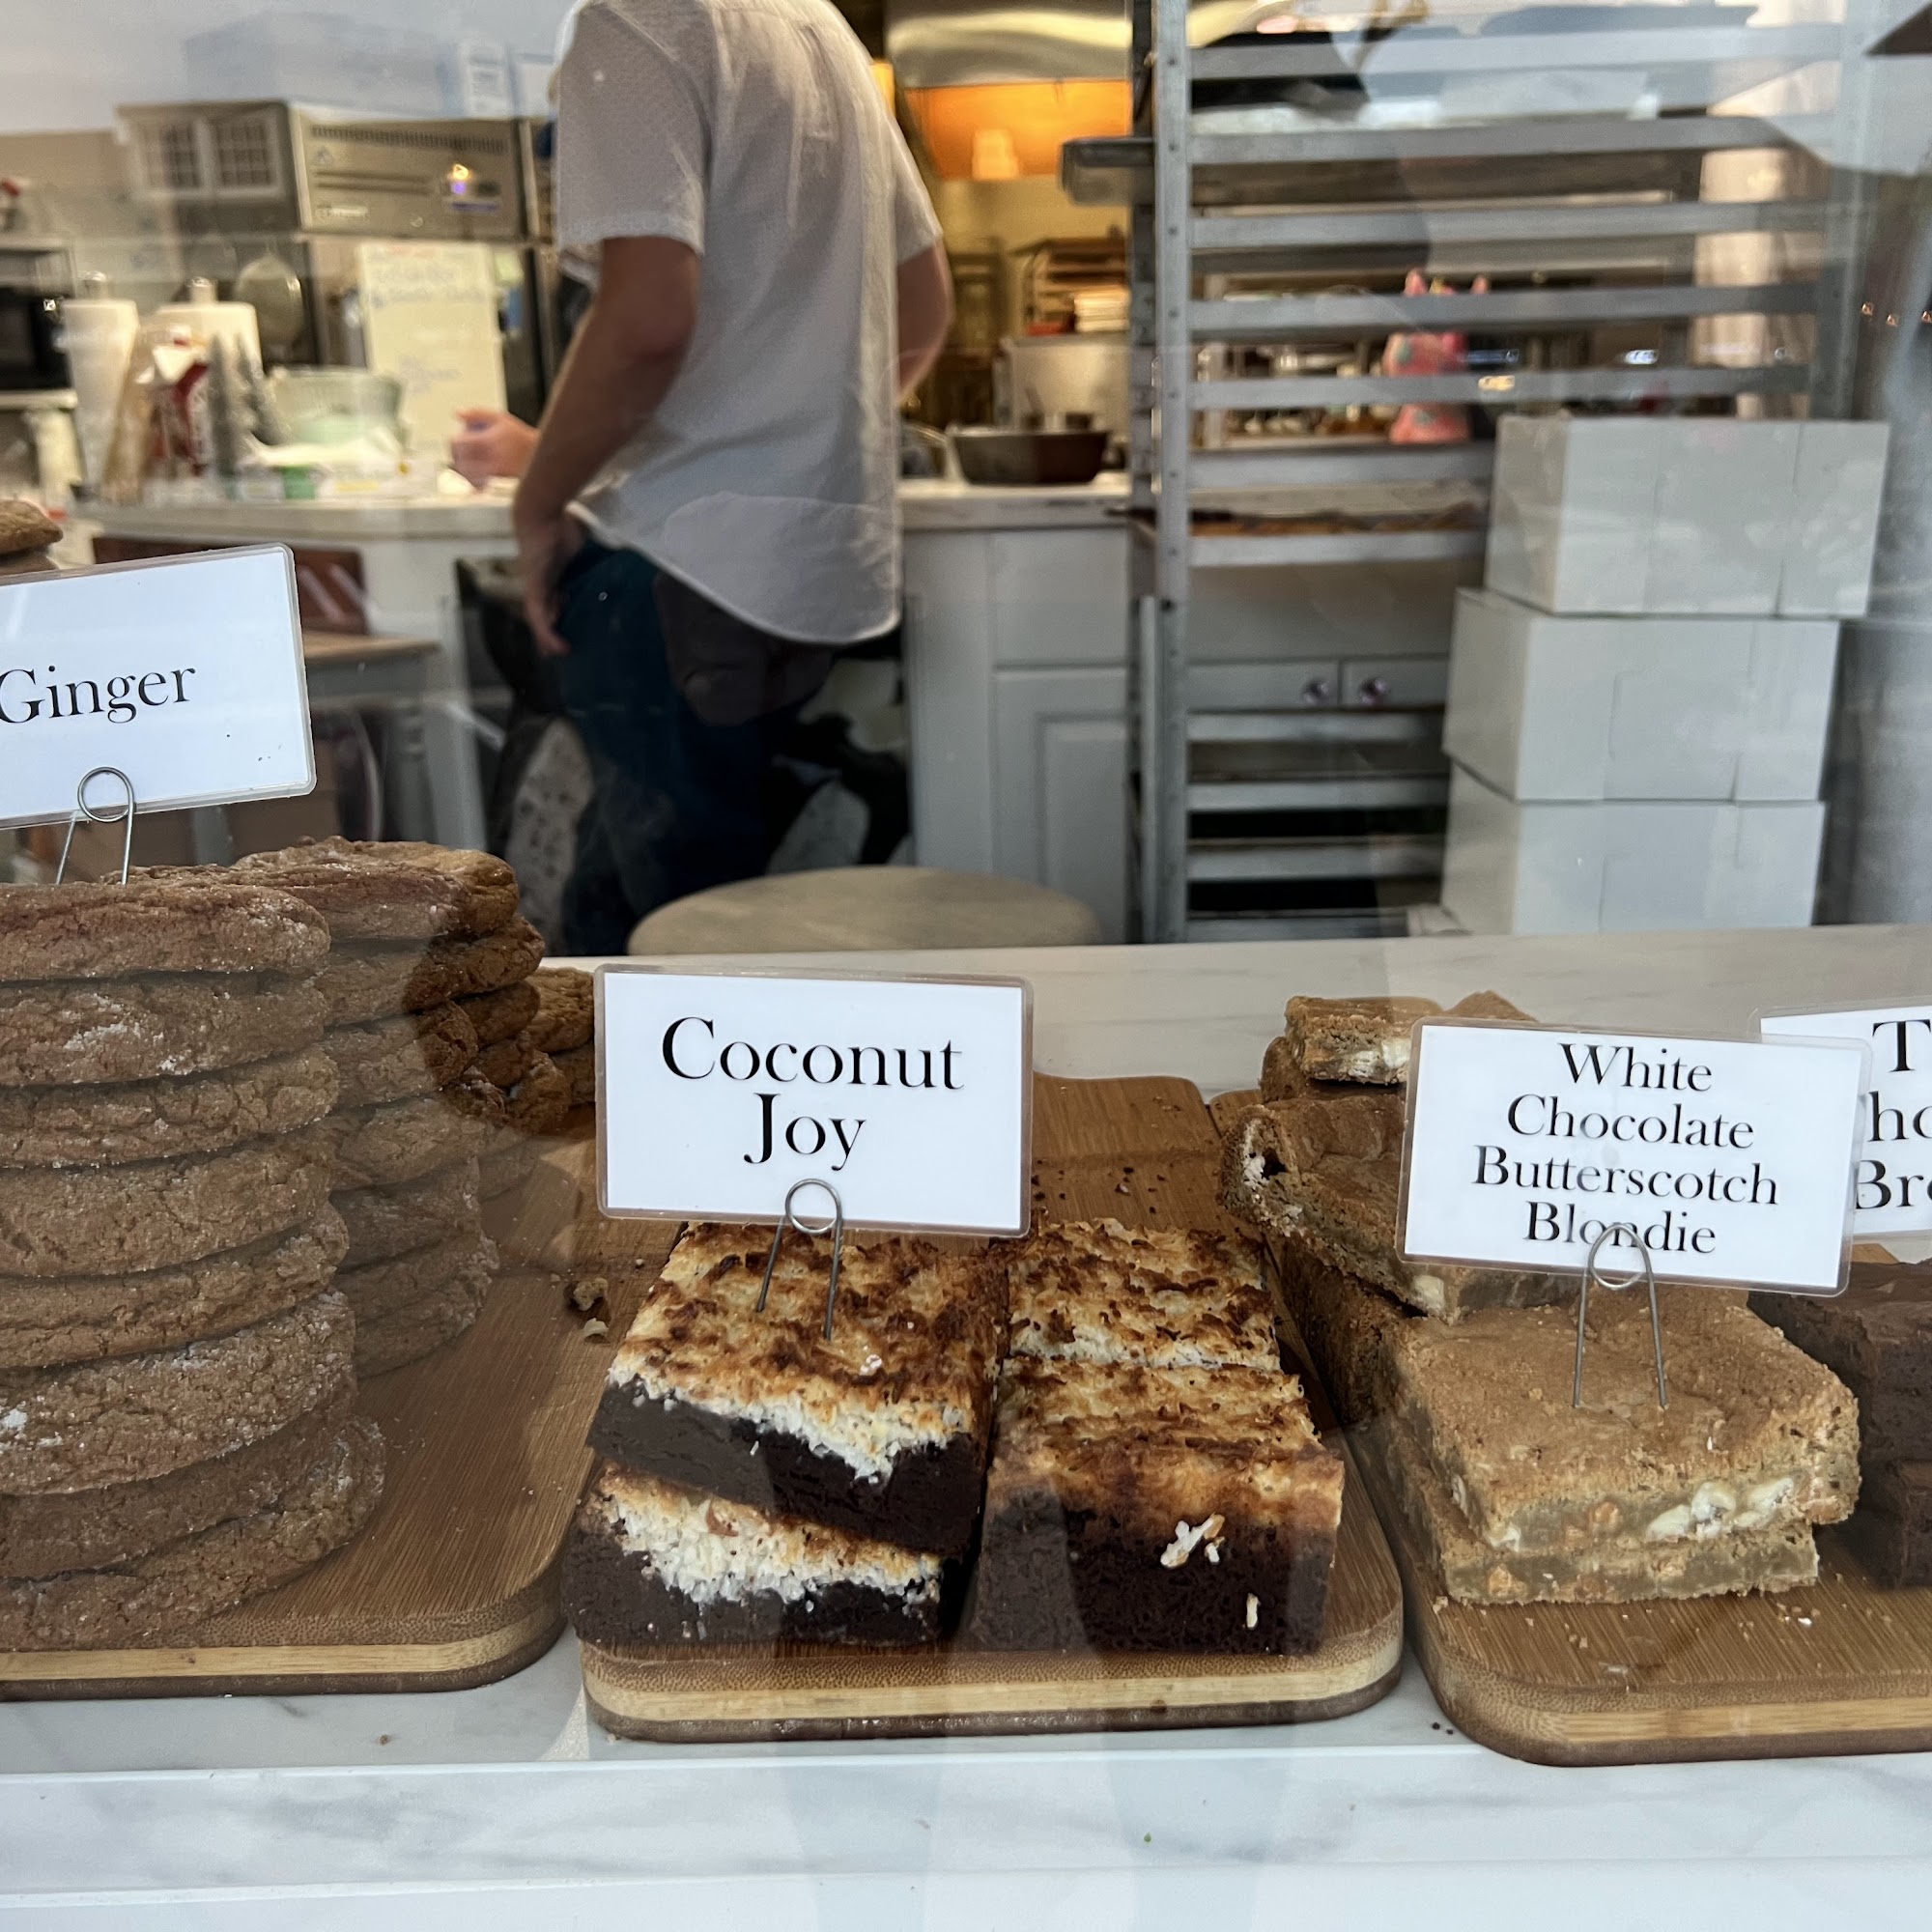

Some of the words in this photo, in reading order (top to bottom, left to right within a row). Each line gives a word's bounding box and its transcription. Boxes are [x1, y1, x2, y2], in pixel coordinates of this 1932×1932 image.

[0, 665, 196, 724] Ginger
[662, 1016, 965, 1090] Coconut
[1558, 1042, 1713, 1093] White
[743, 1093, 867, 1172] Joy
[1507, 1094, 1754, 1150] Chocolate
[1472, 1145, 1778, 1206] Butterscotch
[1854, 1158, 1932, 1210] Br
[1522, 1201, 1717, 1254] Blondie
